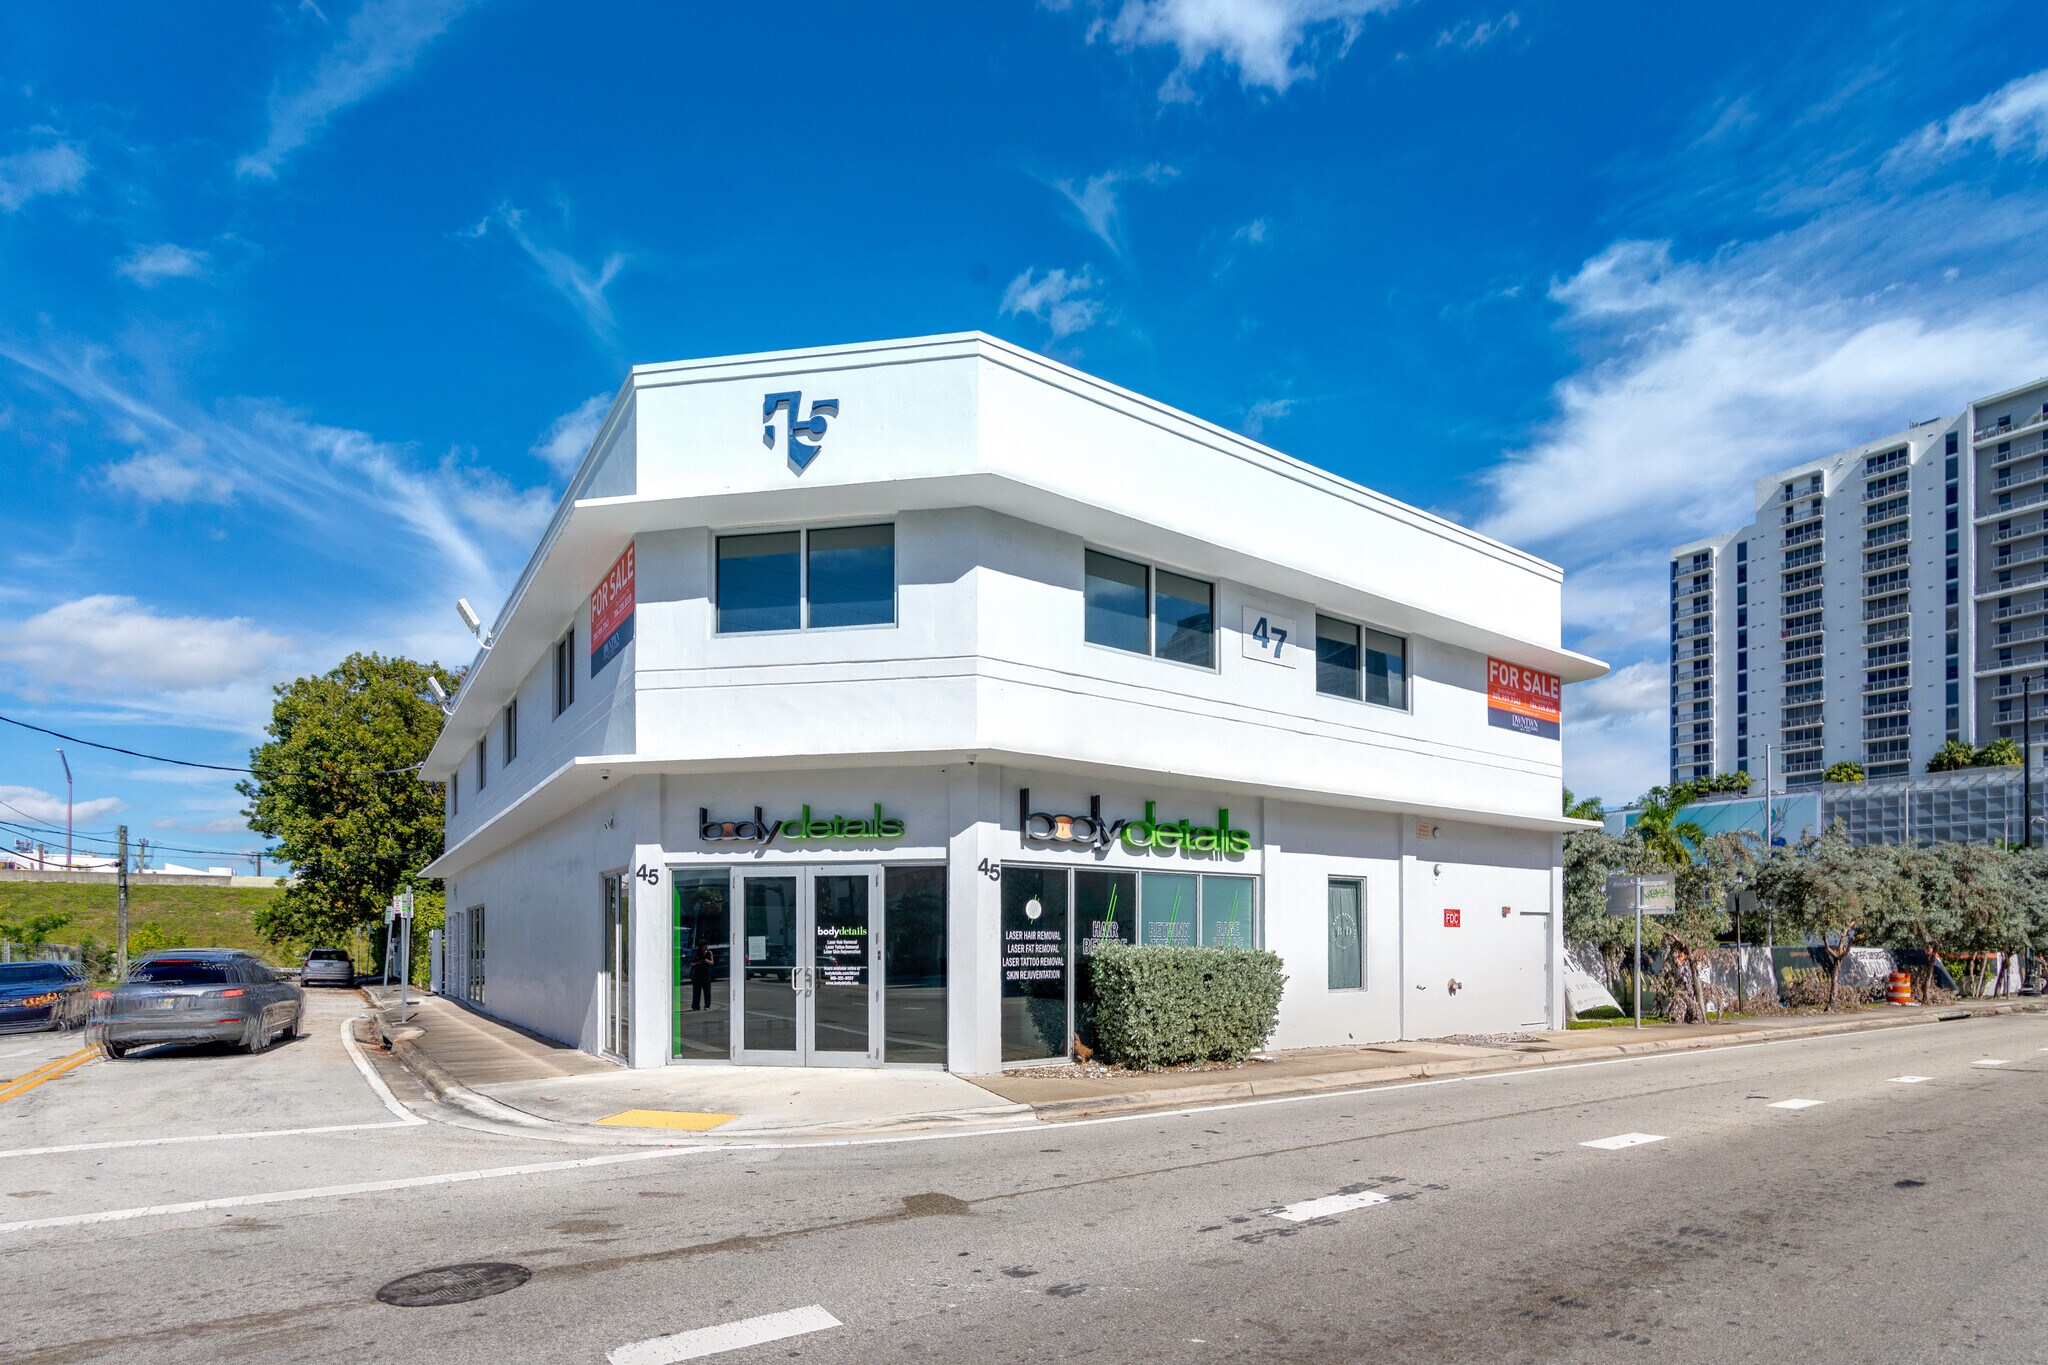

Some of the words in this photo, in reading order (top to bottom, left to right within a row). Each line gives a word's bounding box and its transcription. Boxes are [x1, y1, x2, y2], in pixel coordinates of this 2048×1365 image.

[592, 581, 608, 623] FOR
[610, 547, 634, 601] SALE
[1253, 617, 1287, 659] 47
[1490, 661, 1519, 689] FOR
[1522, 671, 1559, 699] SALE
[636, 863, 659, 885] 45
[978, 858, 1000, 881] 45
[1445, 913, 1459, 924] FDC
[1005, 931, 1023, 940] LASER
[1024, 931, 1036, 940] HAIR
[1037, 931, 1062, 940] REMOVAL
[1092, 921, 1119, 938] HAIR
[1148, 921, 1191, 938] RETHINK
[1007, 944, 1025, 953] LASER
[1025, 944, 1035, 953] FAT
[1035, 944, 1060, 953] REMOVAL
[1002, 958, 1020, 967] LASER
[1020, 957, 1040, 966] TATTOO
[1040, 957, 1065, 966] REMOVAL
[1006, 971, 1019, 980] SKIN
